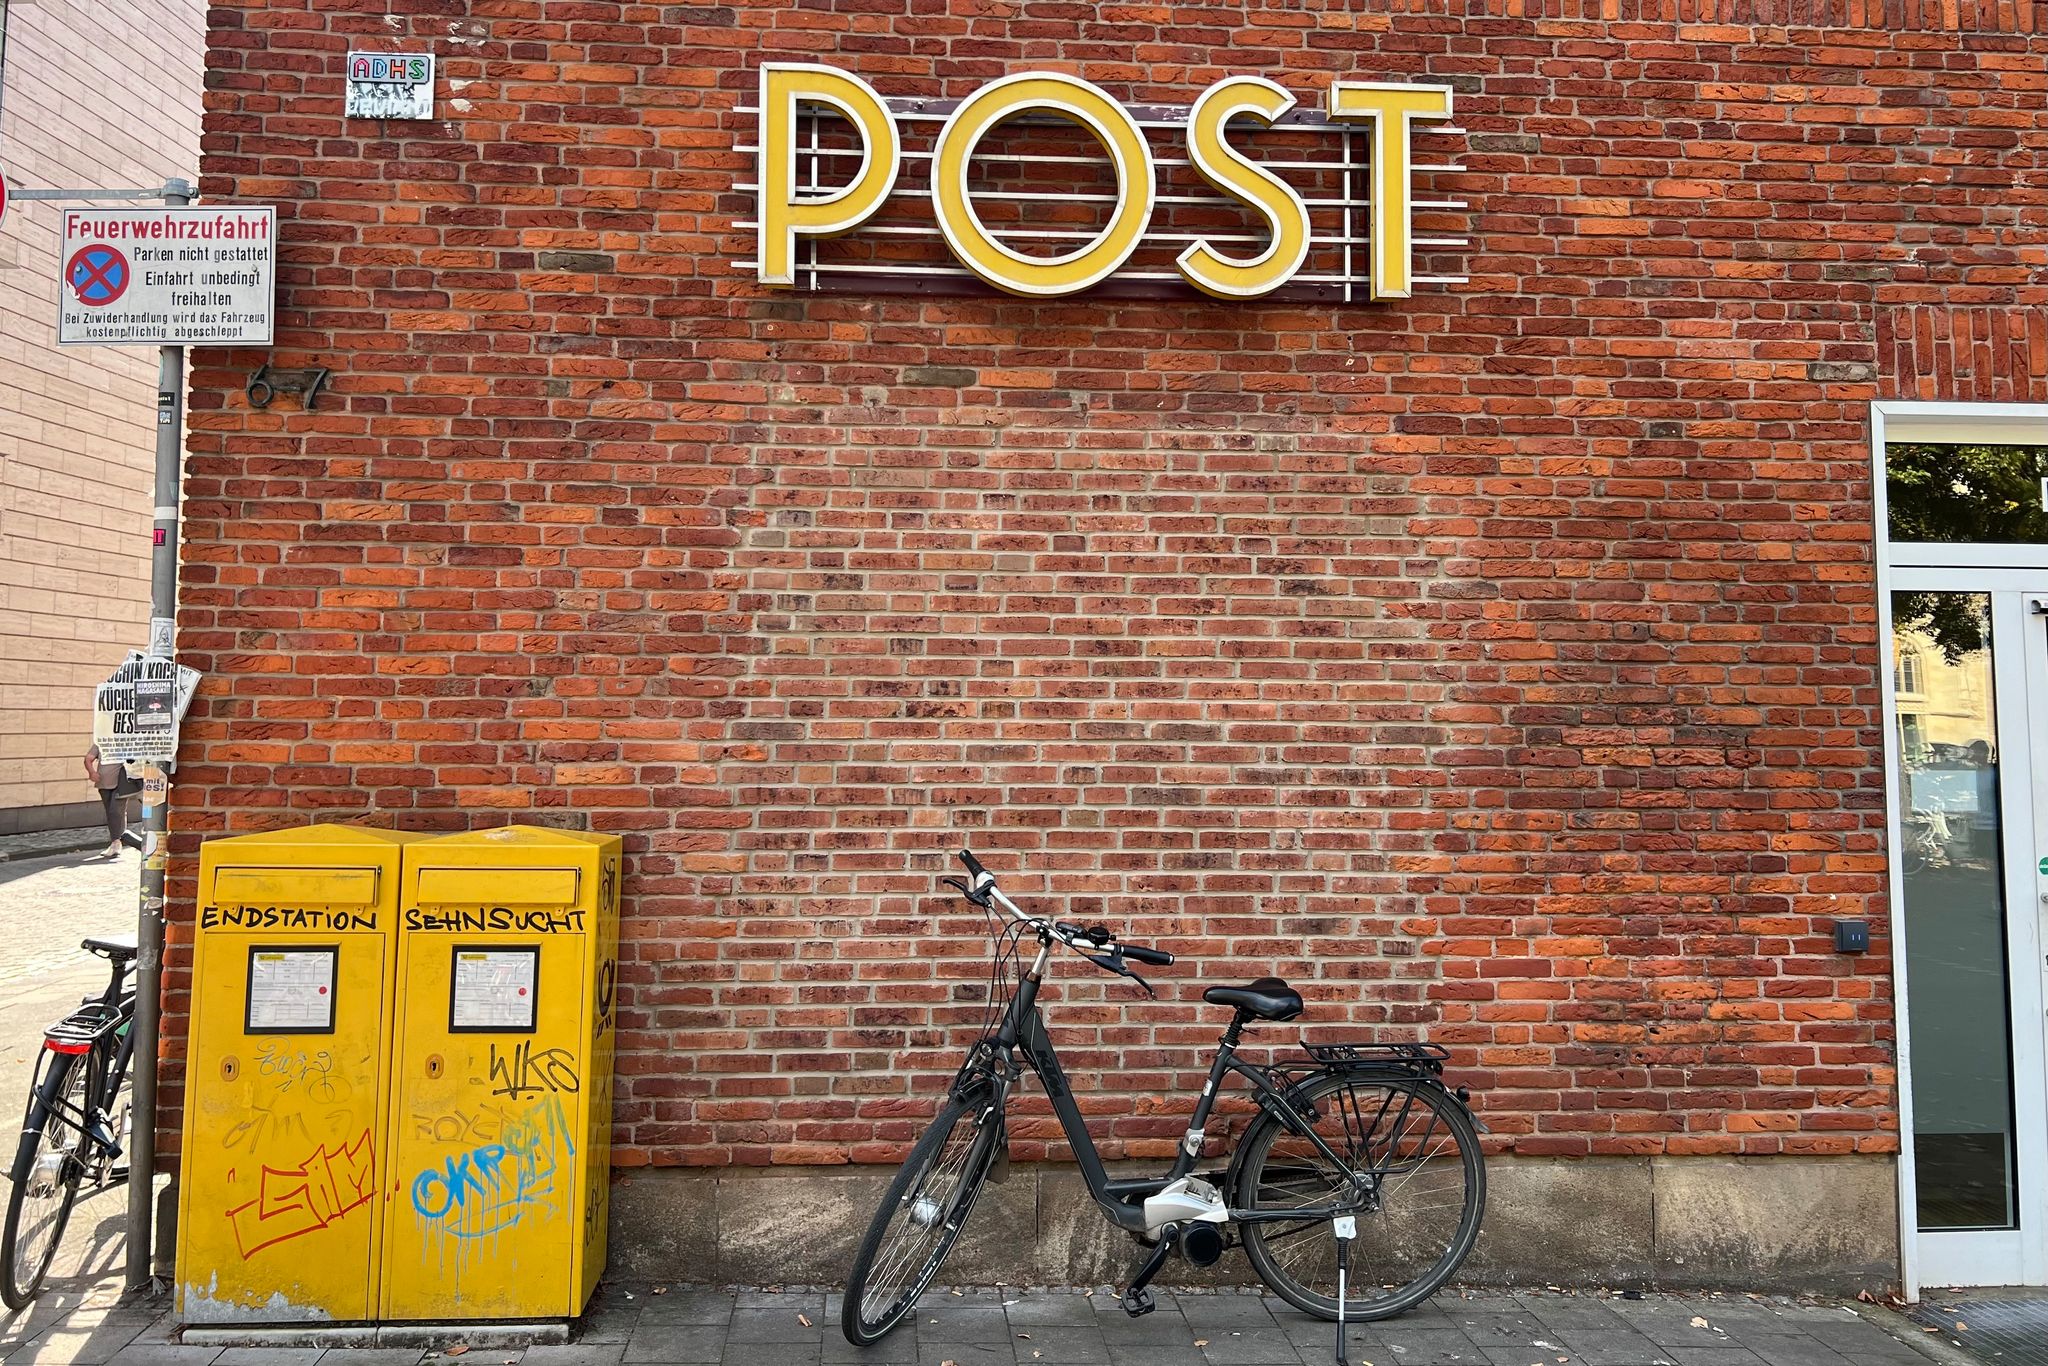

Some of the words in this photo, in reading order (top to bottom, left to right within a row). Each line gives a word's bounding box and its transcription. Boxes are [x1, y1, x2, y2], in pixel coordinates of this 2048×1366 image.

[353, 58, 425, 79] ADHS
[758, 62, 1454, 301] POST
[67, 214, 268, 240] Feuerwehrzufahrt
[133, 247, 174, 261] Parken
[179, 246, 209, 261] nicht
[214, 247, 268, 263] gestattet
[145, 272, 194, 286] Einfahrt
[201, 271, 260, 287] unbedingt
[171, 291, 232, 306] freihalten
[65, 313, 80, 324] Bei
[83, 312, 168, 325] Zuwiderhandlung
[172, 312, 196, 323] wird
[199, 312, 217, 323] das
[221, 311, 265, 324] Fahrzeug
[86, 325, 167, 338] kostenpflichtig
[174, 325, 243, 338] abgeschleppt
